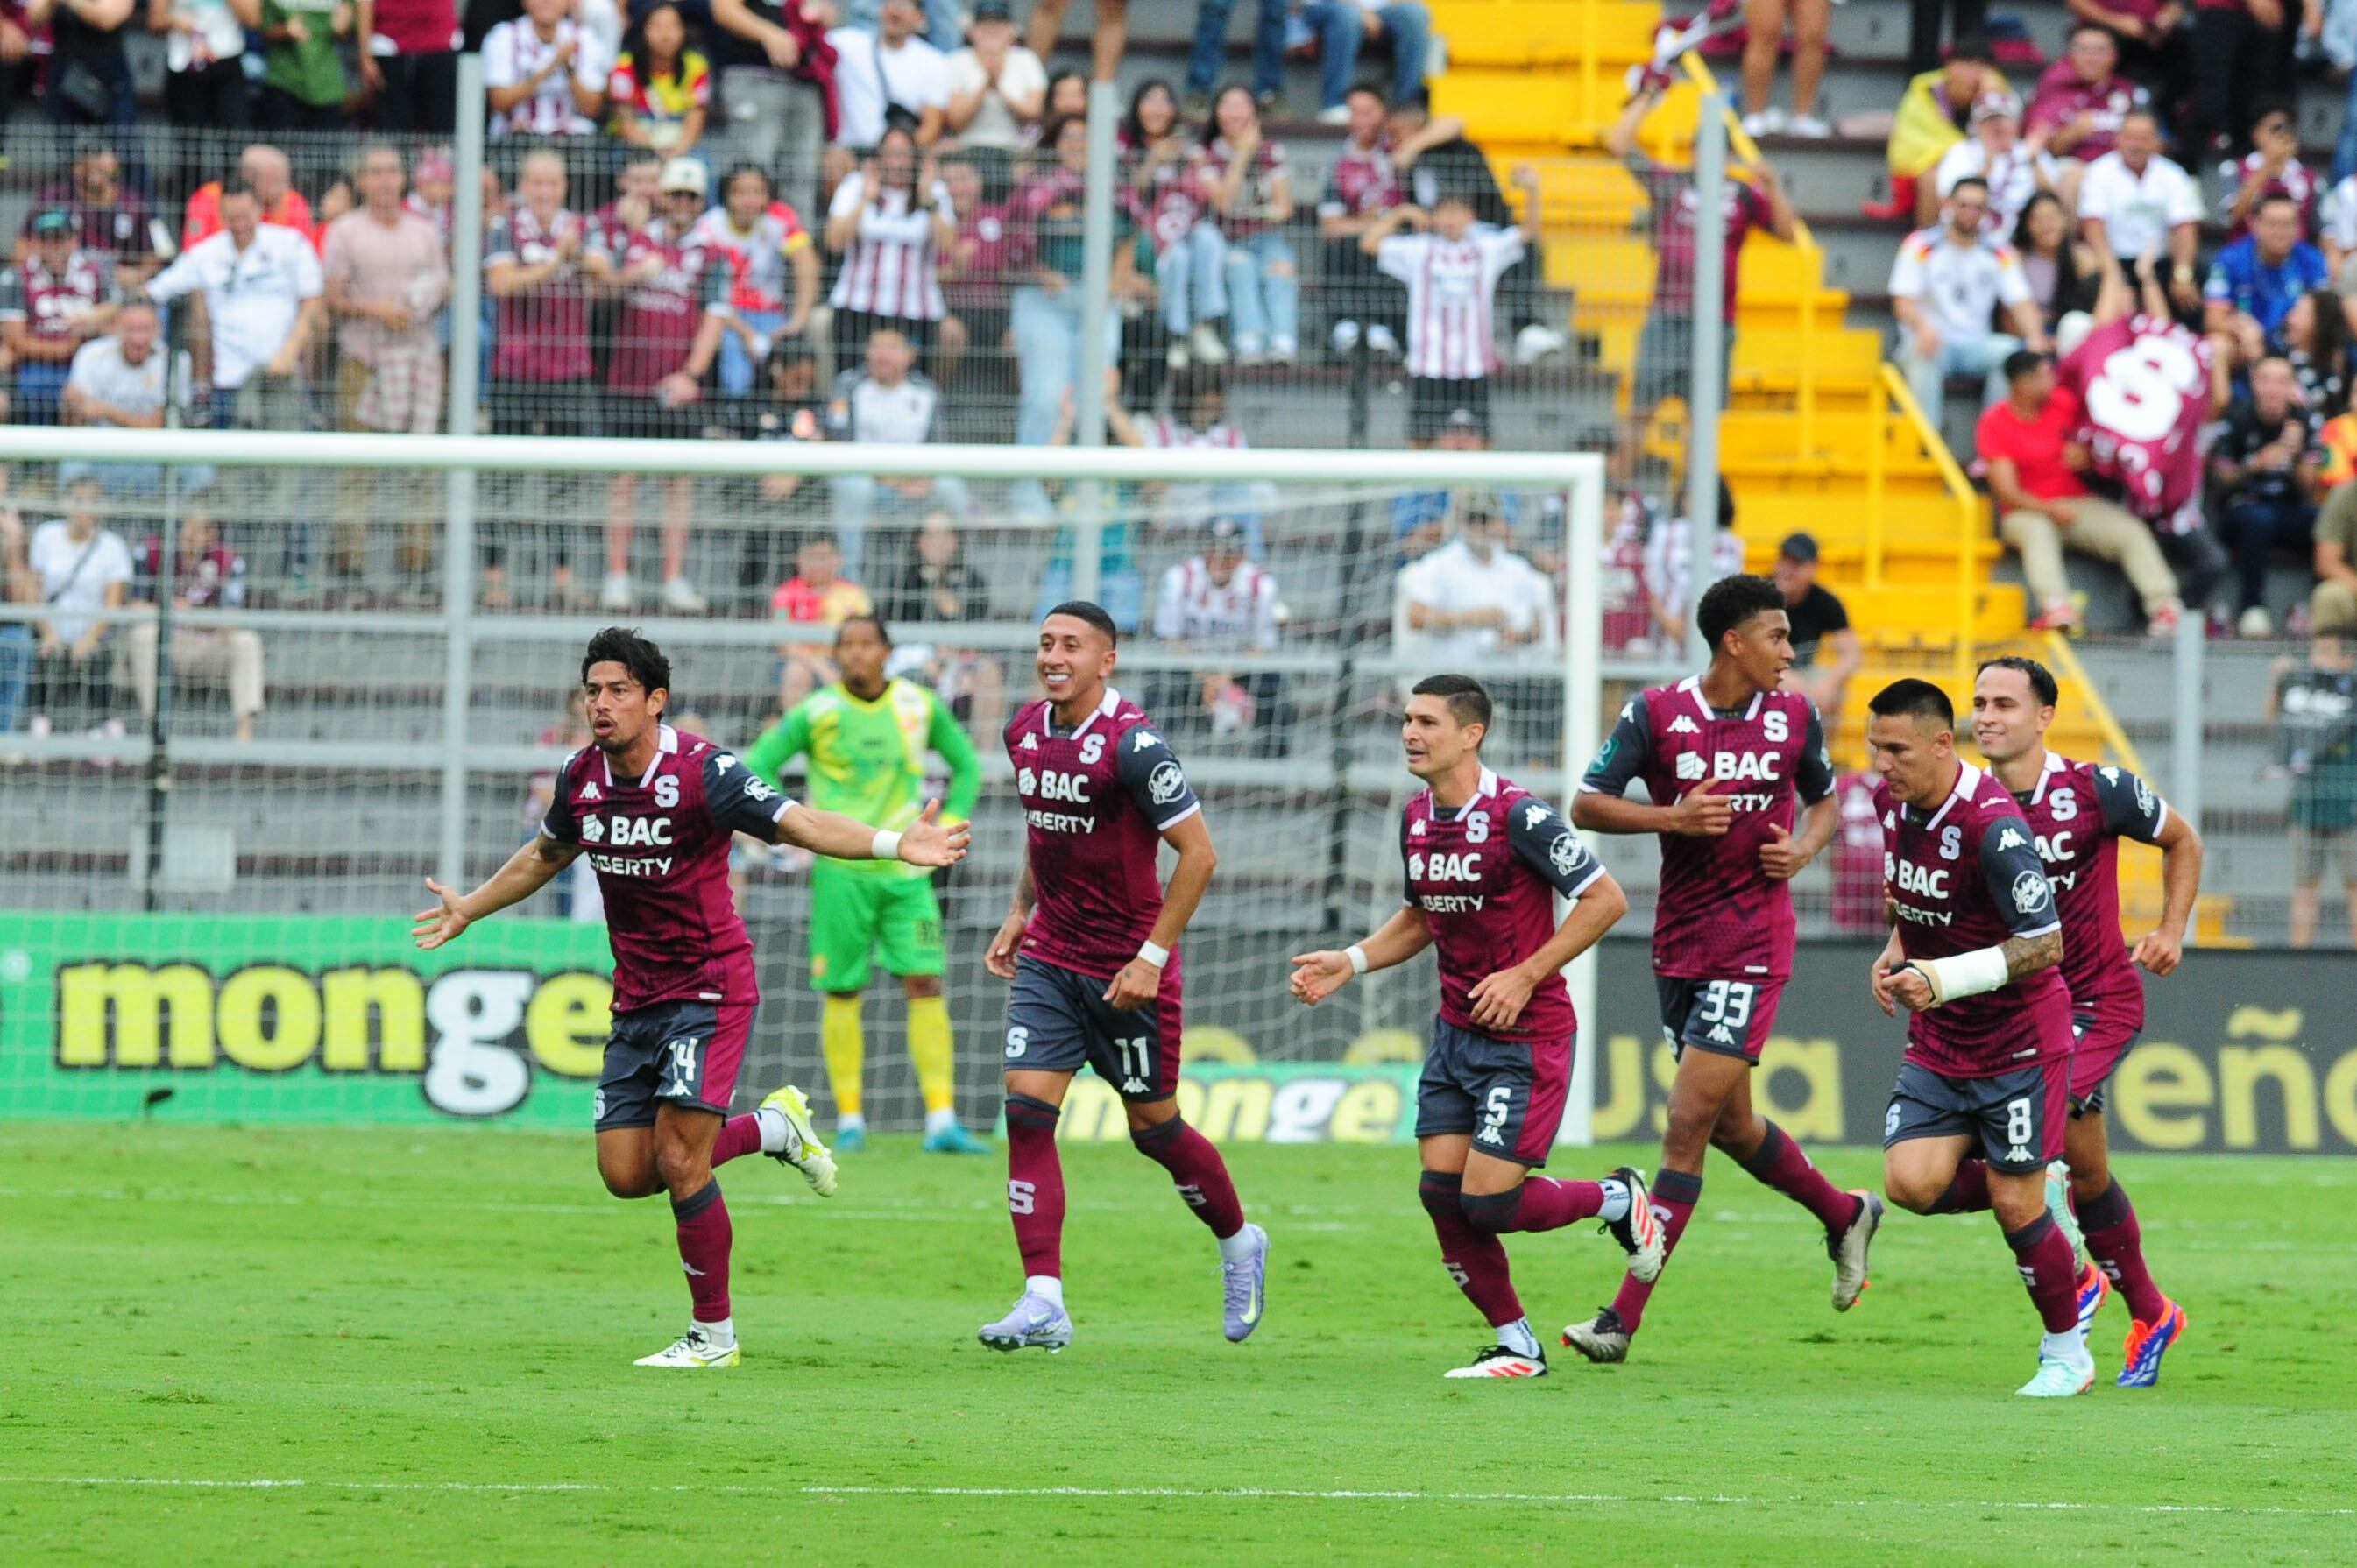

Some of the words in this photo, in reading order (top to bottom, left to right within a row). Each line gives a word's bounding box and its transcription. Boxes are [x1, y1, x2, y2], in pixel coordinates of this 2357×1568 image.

[1763, 710, 1788, 742] S
[1079, 733, 1106, 764] S
[1714, 751, 1780, 780] BAC
[655, 774, 680, 808] S
[1041, 770, 1091, 803] BAC
[2049, 787, 2077, 821] S
[611, 816, 673, 846] BAC
[1465, 811, 1490, 844] S
[1939, 825, 1961, 860] S
[2035, 830, 2075, 863] AC
[1428, 852, 1482, 882] BAC
[1898, 858, 1950, 899] BAC
[1701, 980, 1753, 1028] 33
[56, 960, 617, 1119] monge
[1005, 1026, 1029, 1058] S
[1114, 1036, 1150, 1077] 11
[669, 1037, 698, 1082] 14
[2007, 1098, 2033, 1145] 8
[1009, 1179, 1036, 1215] S
